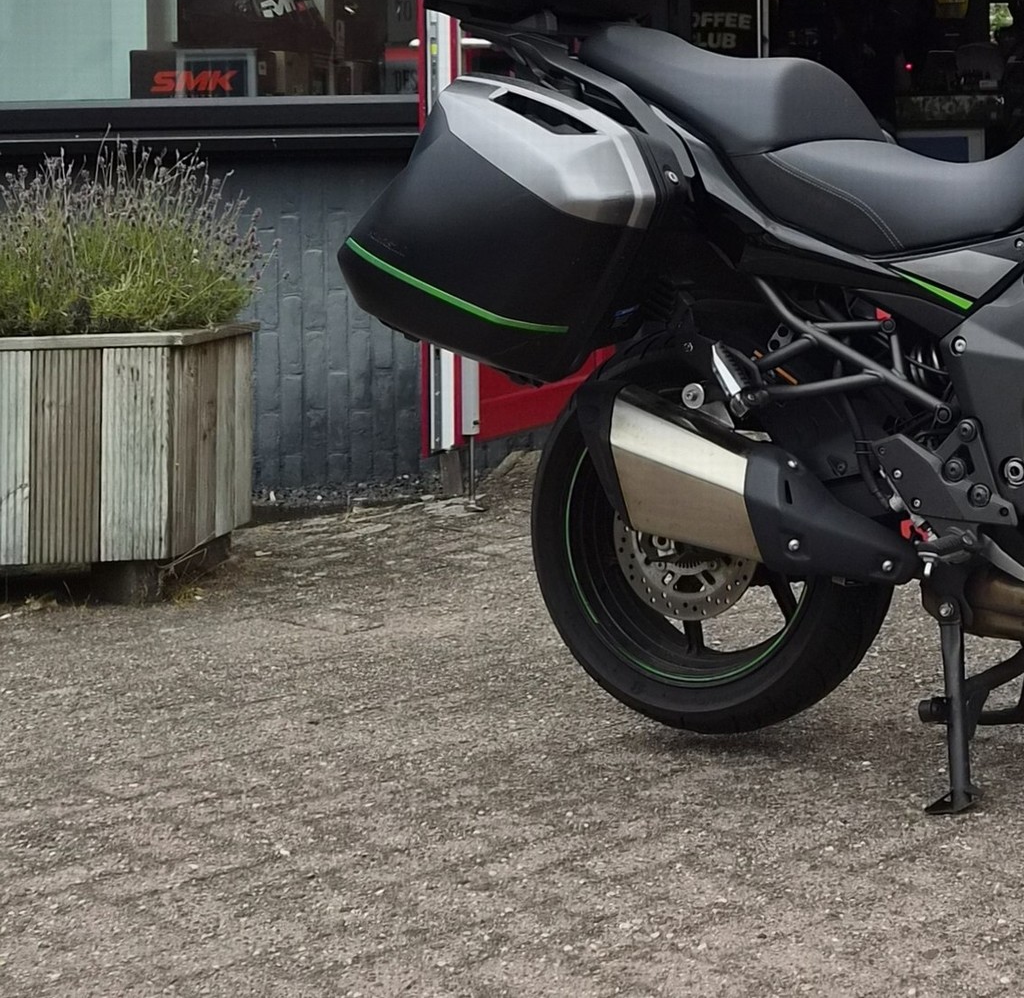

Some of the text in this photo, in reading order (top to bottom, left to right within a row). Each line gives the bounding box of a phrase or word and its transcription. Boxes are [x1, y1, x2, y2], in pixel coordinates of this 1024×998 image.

[691, 11, 753, 31] OFFEE
[692, 32, 737, 50] LUB
[149, 70, 239, 93] SMK
